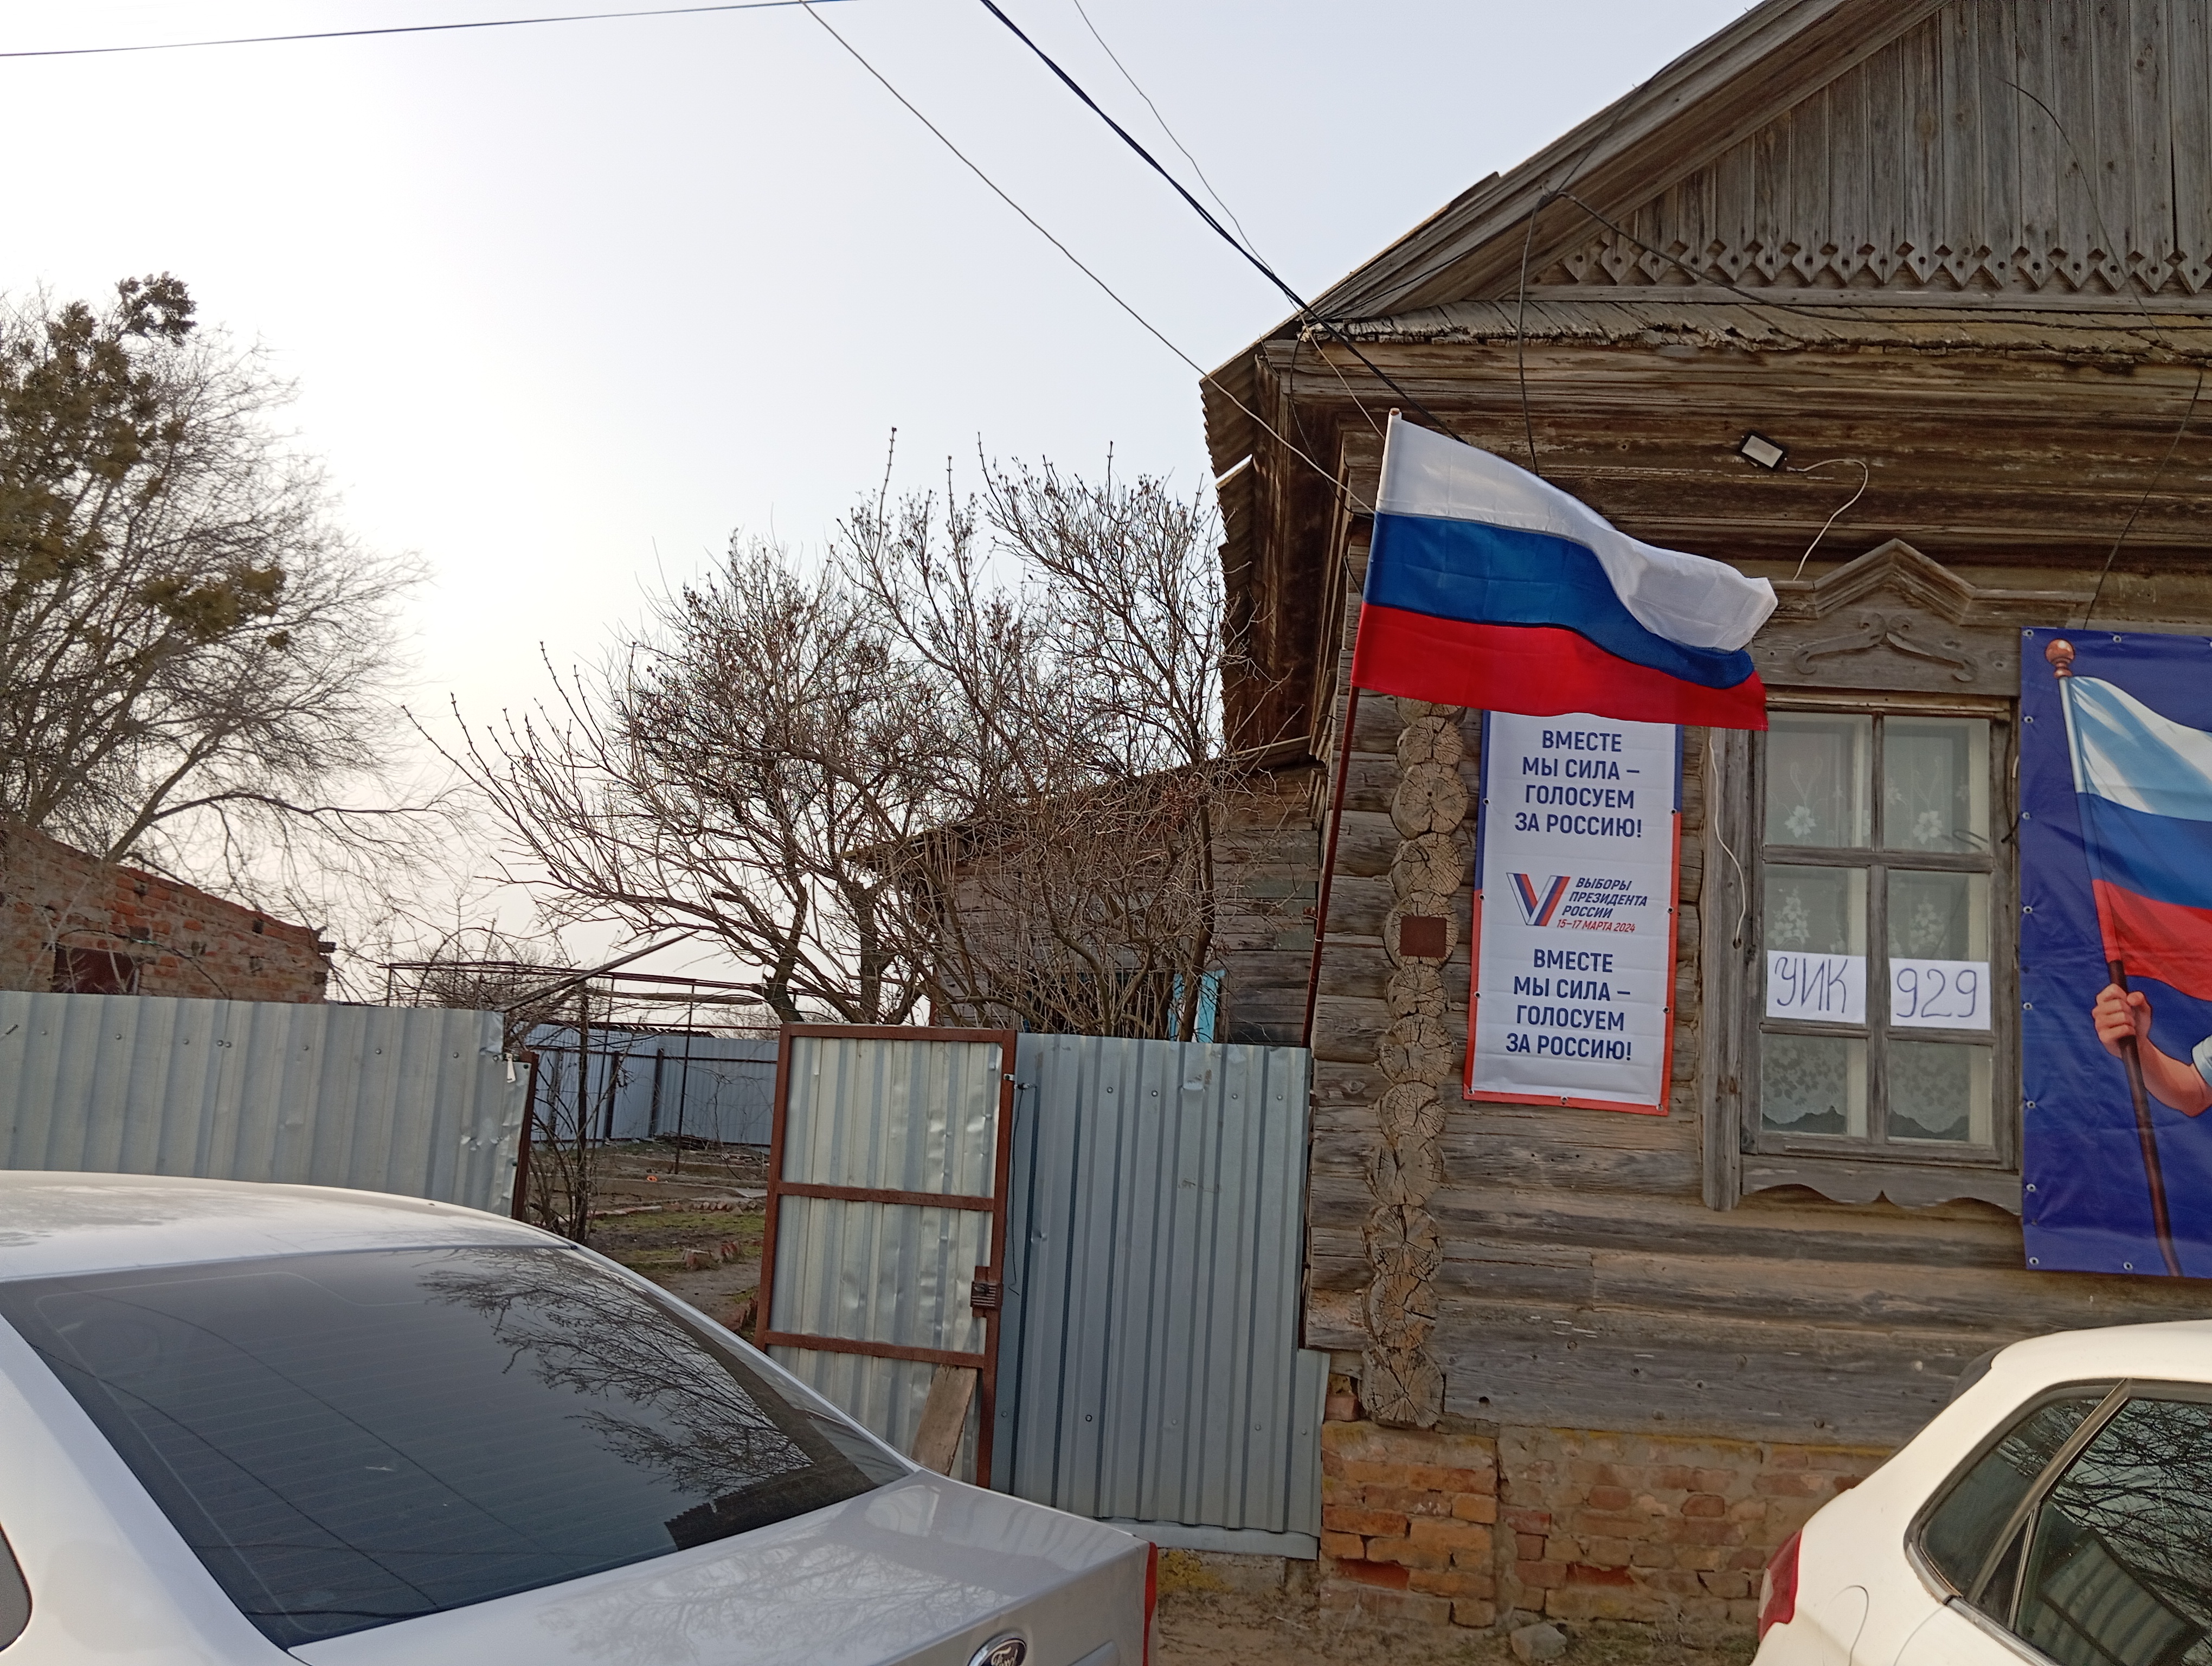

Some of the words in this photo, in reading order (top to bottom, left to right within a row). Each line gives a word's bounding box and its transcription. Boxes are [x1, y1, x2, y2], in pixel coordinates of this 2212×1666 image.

[1542, 730, 1622, 752] ВМЕСТЕ
[1522, 757, 1558, 777] МЫ
[1565, 759, 1620, 780] СИЛА
[1525, 784, 1635, 809] ГОЛОСУЕМ
[1514, 812, 1540, 832] ЗА
[1546, 814, 1642, 838] РОССИЮ!
[1576, 877, 1632, 890] ВЫБОРЫ
[1568, 891, 1648, 906] ПРЕЗИДЕНТА
[1561, 905, 1613, 918] РОССИИ
[1581, 920, 1612, 931] МАРТА
[1613, 922, 1636, 933] 2024
[1533, 949, 1613, 973] ВМЕСТЕ
[1513, 976, 1549, 997] МЫ
[1556, 979, 1611, 1001] СИЛА
[1774, 956, 1848, 1013] УИК
[1896, 967, 1977, 1018] 929
[1516, 1005, 1625, 1031] ГОЛОСУЕМ
[1506, 1033, 1531, 1053] ЗА
[1536, 1035, 1631, 1061] РОССИЮ!
